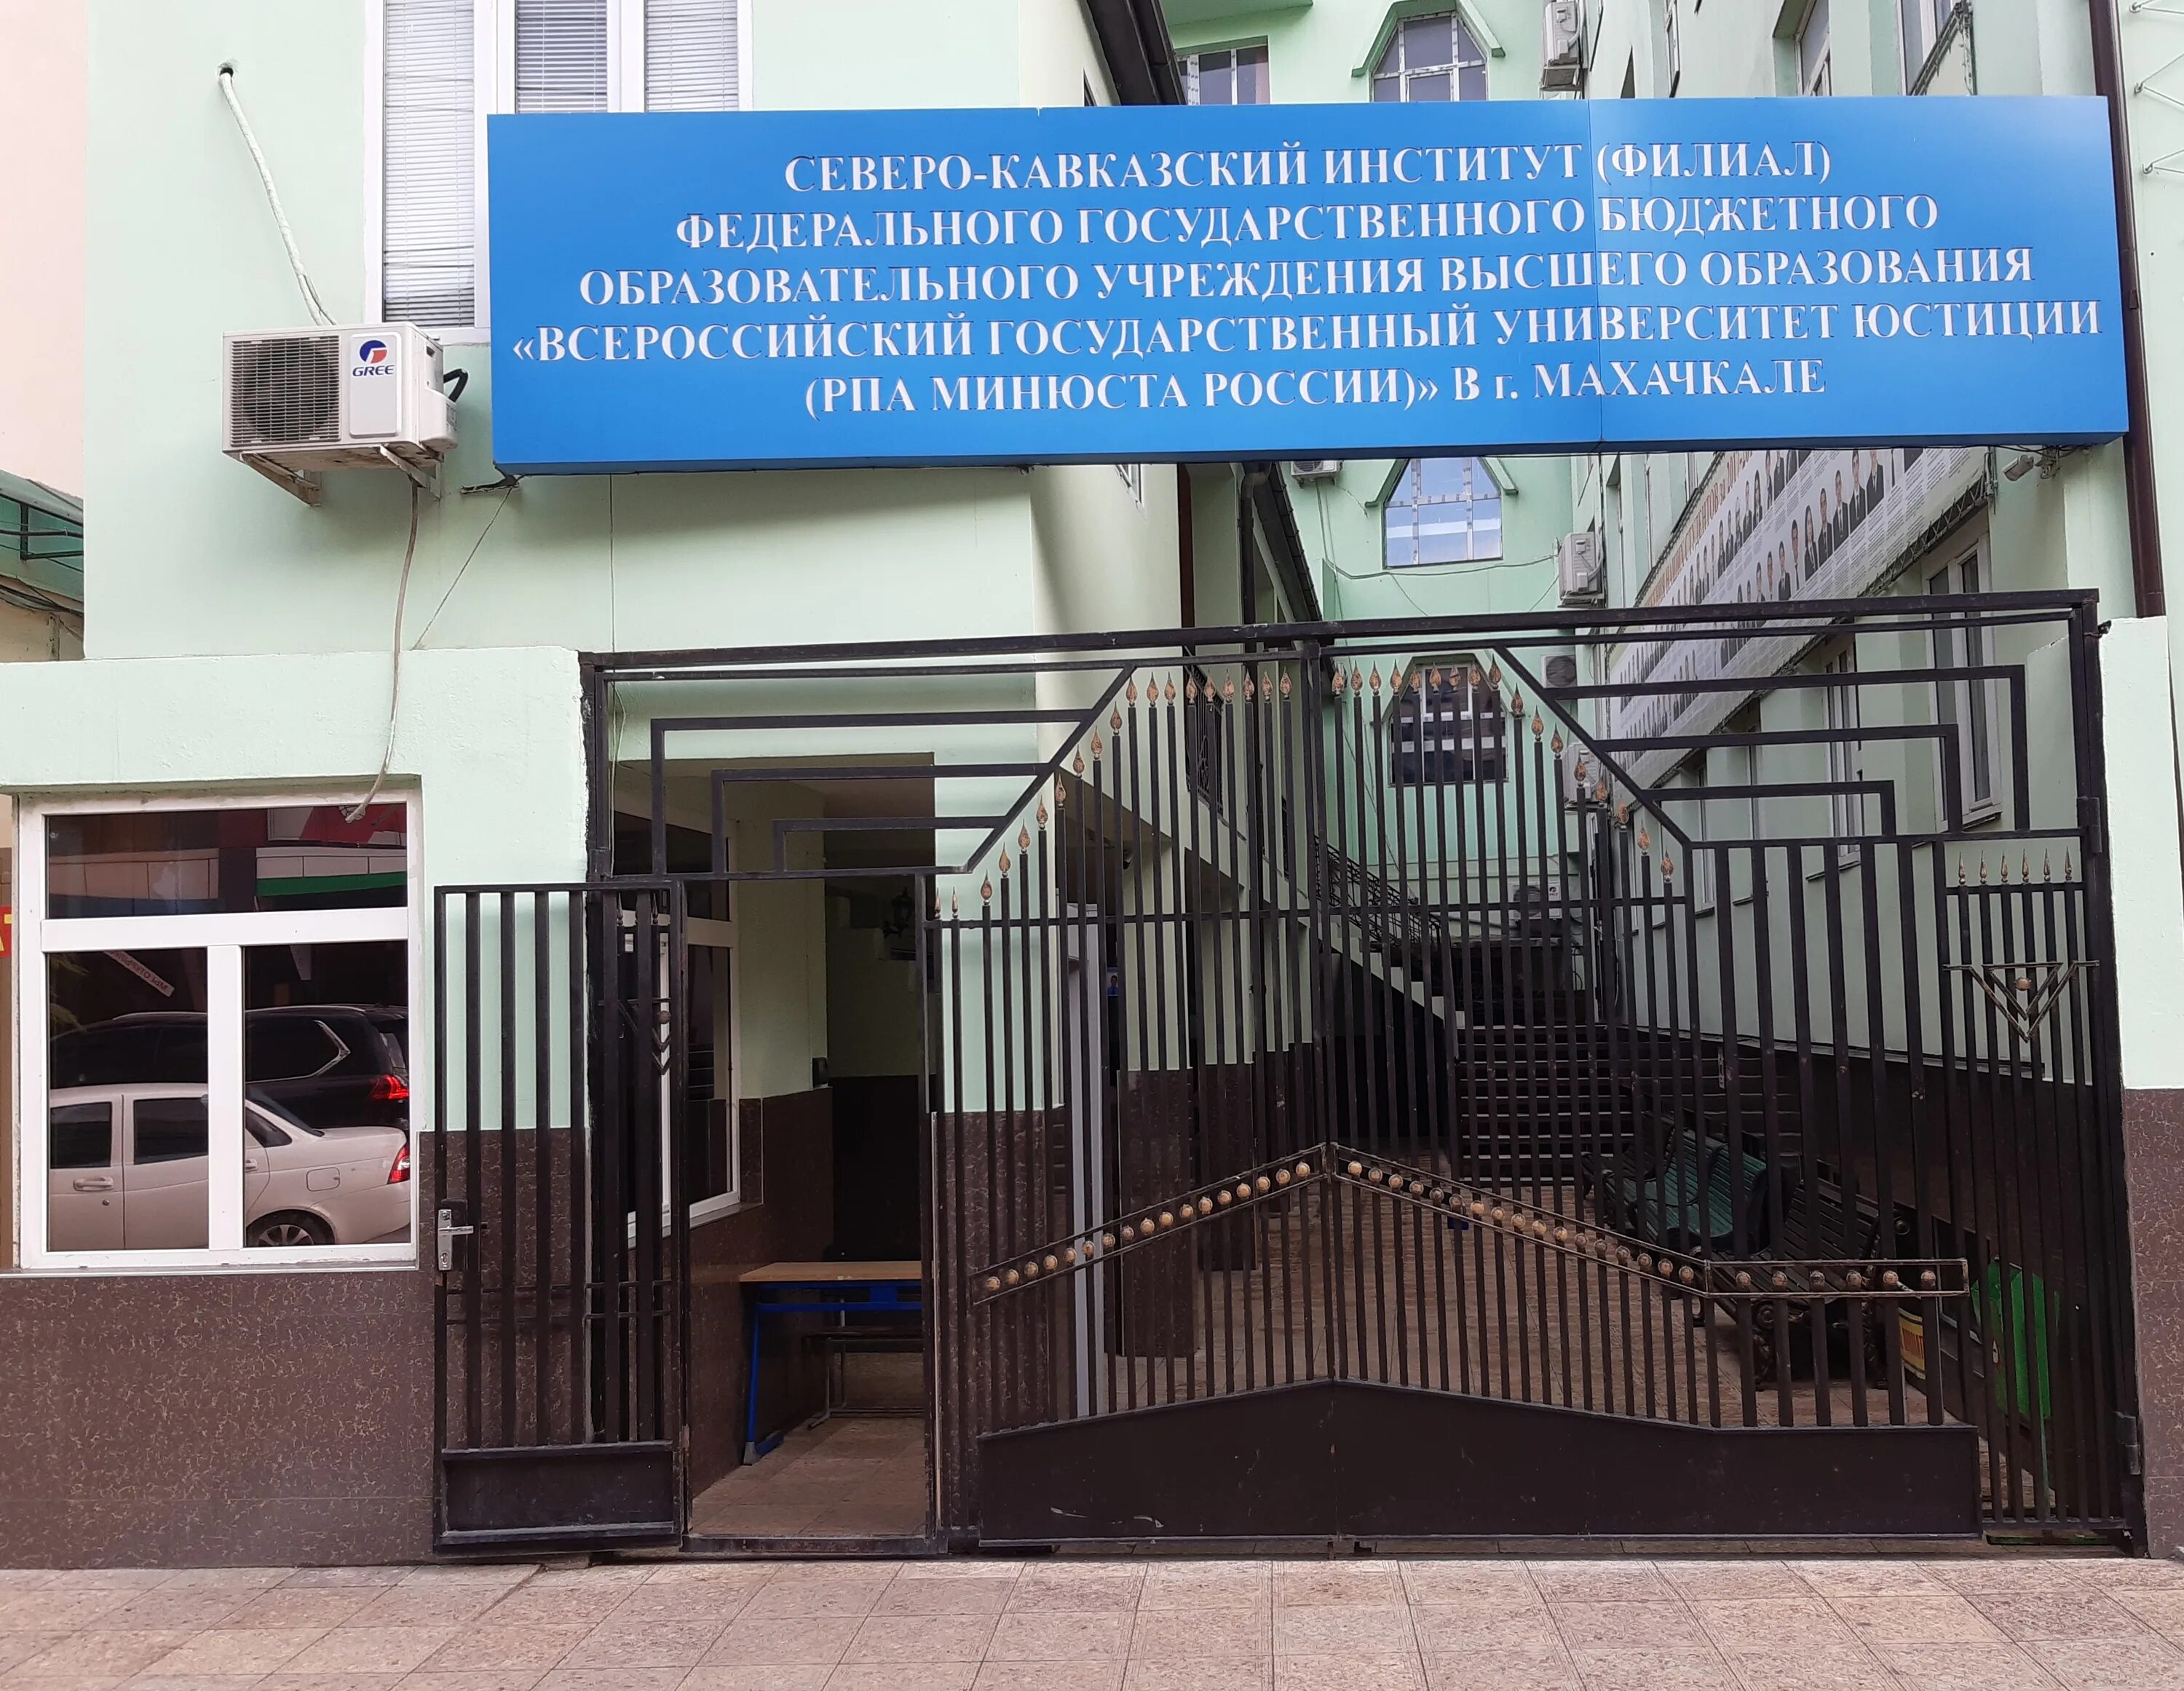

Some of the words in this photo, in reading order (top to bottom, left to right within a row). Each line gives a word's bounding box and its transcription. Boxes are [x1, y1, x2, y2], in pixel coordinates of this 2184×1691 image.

[785, 141, 1306, 191] СЕВЕРО-КАВКАЗСКИЙ
[1325, 144, 1582, 184] ИНСТИТУТ
[1597, 143, 1830, 184] (ФИЛИАЛ)
[676, 210, 1063, 253] ФЕДЕРАЛЬНОГО
[1080, 199, 1585, 248] ГОСУДАРСТВЕННОГО
[1601, 195, 1938, 237] БЮДЖЕТНОГО
[579, 265, 1079, 305] ОБРАЗОВАТЕЛЬНОГО
[1094, 258, 1423, 301] УЧРЕЖДЕНИЯ
[1441, 252, 1687, 291] ВЫСШЕГО
[1700, 248, 2031, 286] ОБРАЗОВАНИЯ
[513, 312, 971, 361] «ВСЕРОССИЙСКИЙ
[990, 302, 1476, 360] ГОСУДАРСТВЕННЫЙ
[1494, 305, 1837, 344] УНИВЕРСИТЕТ
[1854, 301, 2098, 341] ЮСТИЦИИ
[352, 365, 395, 377] GREE
[805, 378, 915, 419] (РПА
[933, 374, 1188, 411] МИНЮСТА
[1205, 369, 1439, 410] РОССИИ)»
[1455, 367, 1480, 400] В
[1495, 376, 1518, 399] г.
[1535, 360, 1825, 397] МАХАЧКАЛЕ
